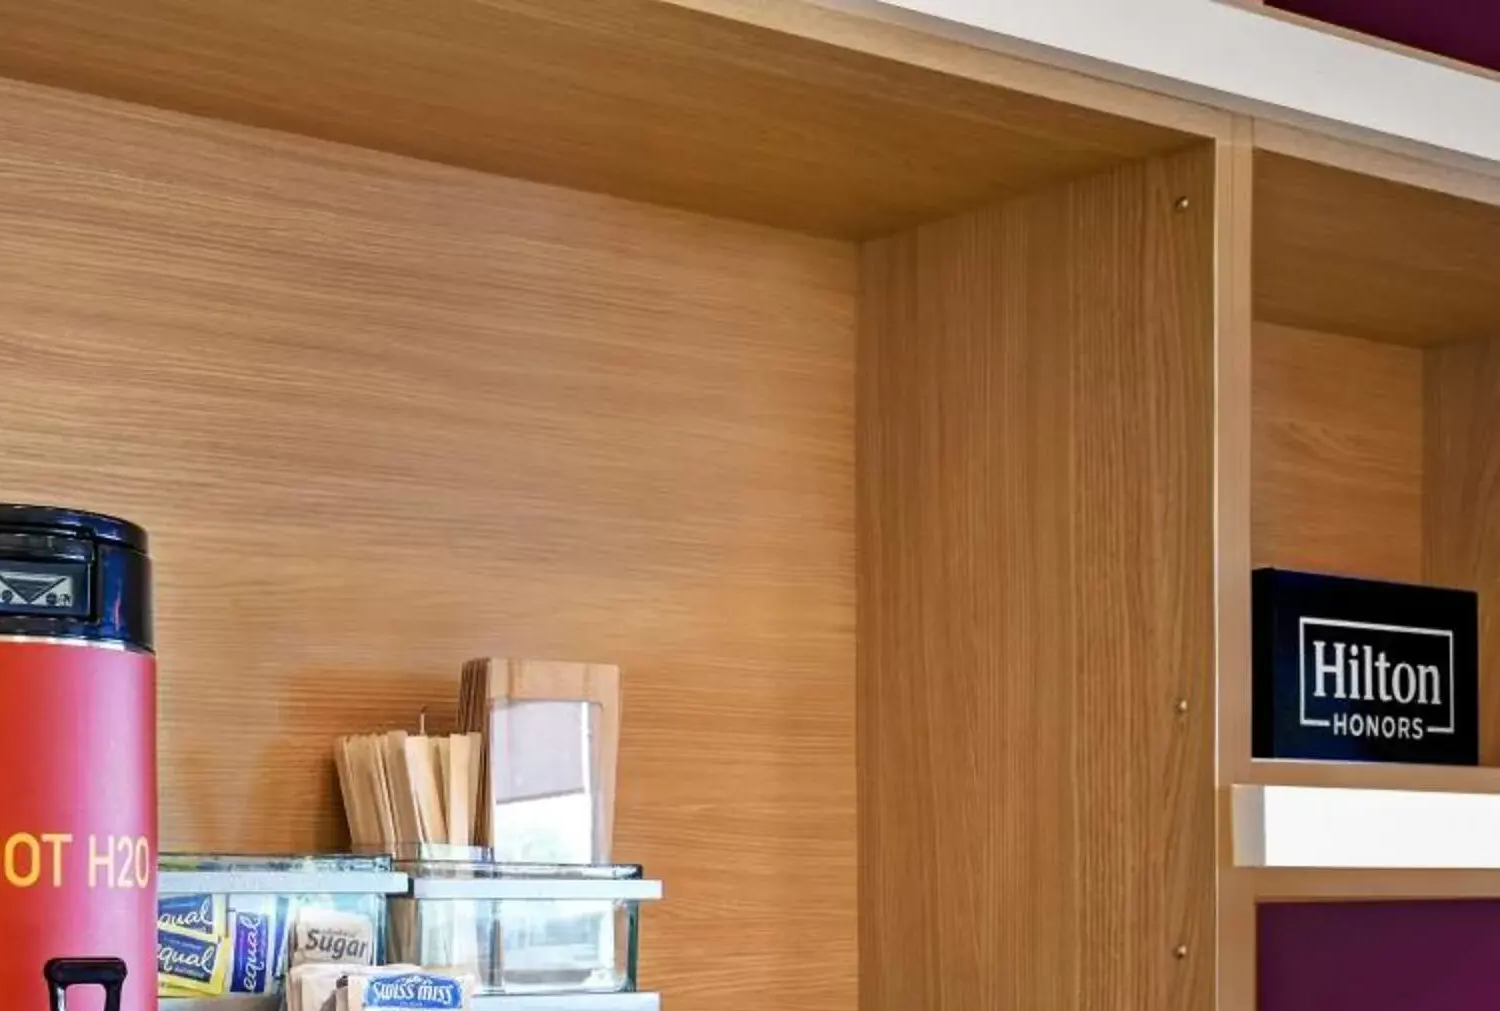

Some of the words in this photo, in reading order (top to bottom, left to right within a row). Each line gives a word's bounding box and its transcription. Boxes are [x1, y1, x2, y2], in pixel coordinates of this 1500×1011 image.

[1312, 640, 1442, 705] Hilton
[1333, 713, 1424, 740] HONORS
[157, 895, 213, 927] qual
[157, 945, 213, 974] qual
[243, 914, 265, 990] equal
[305, 928, 367, 960] Sugar
